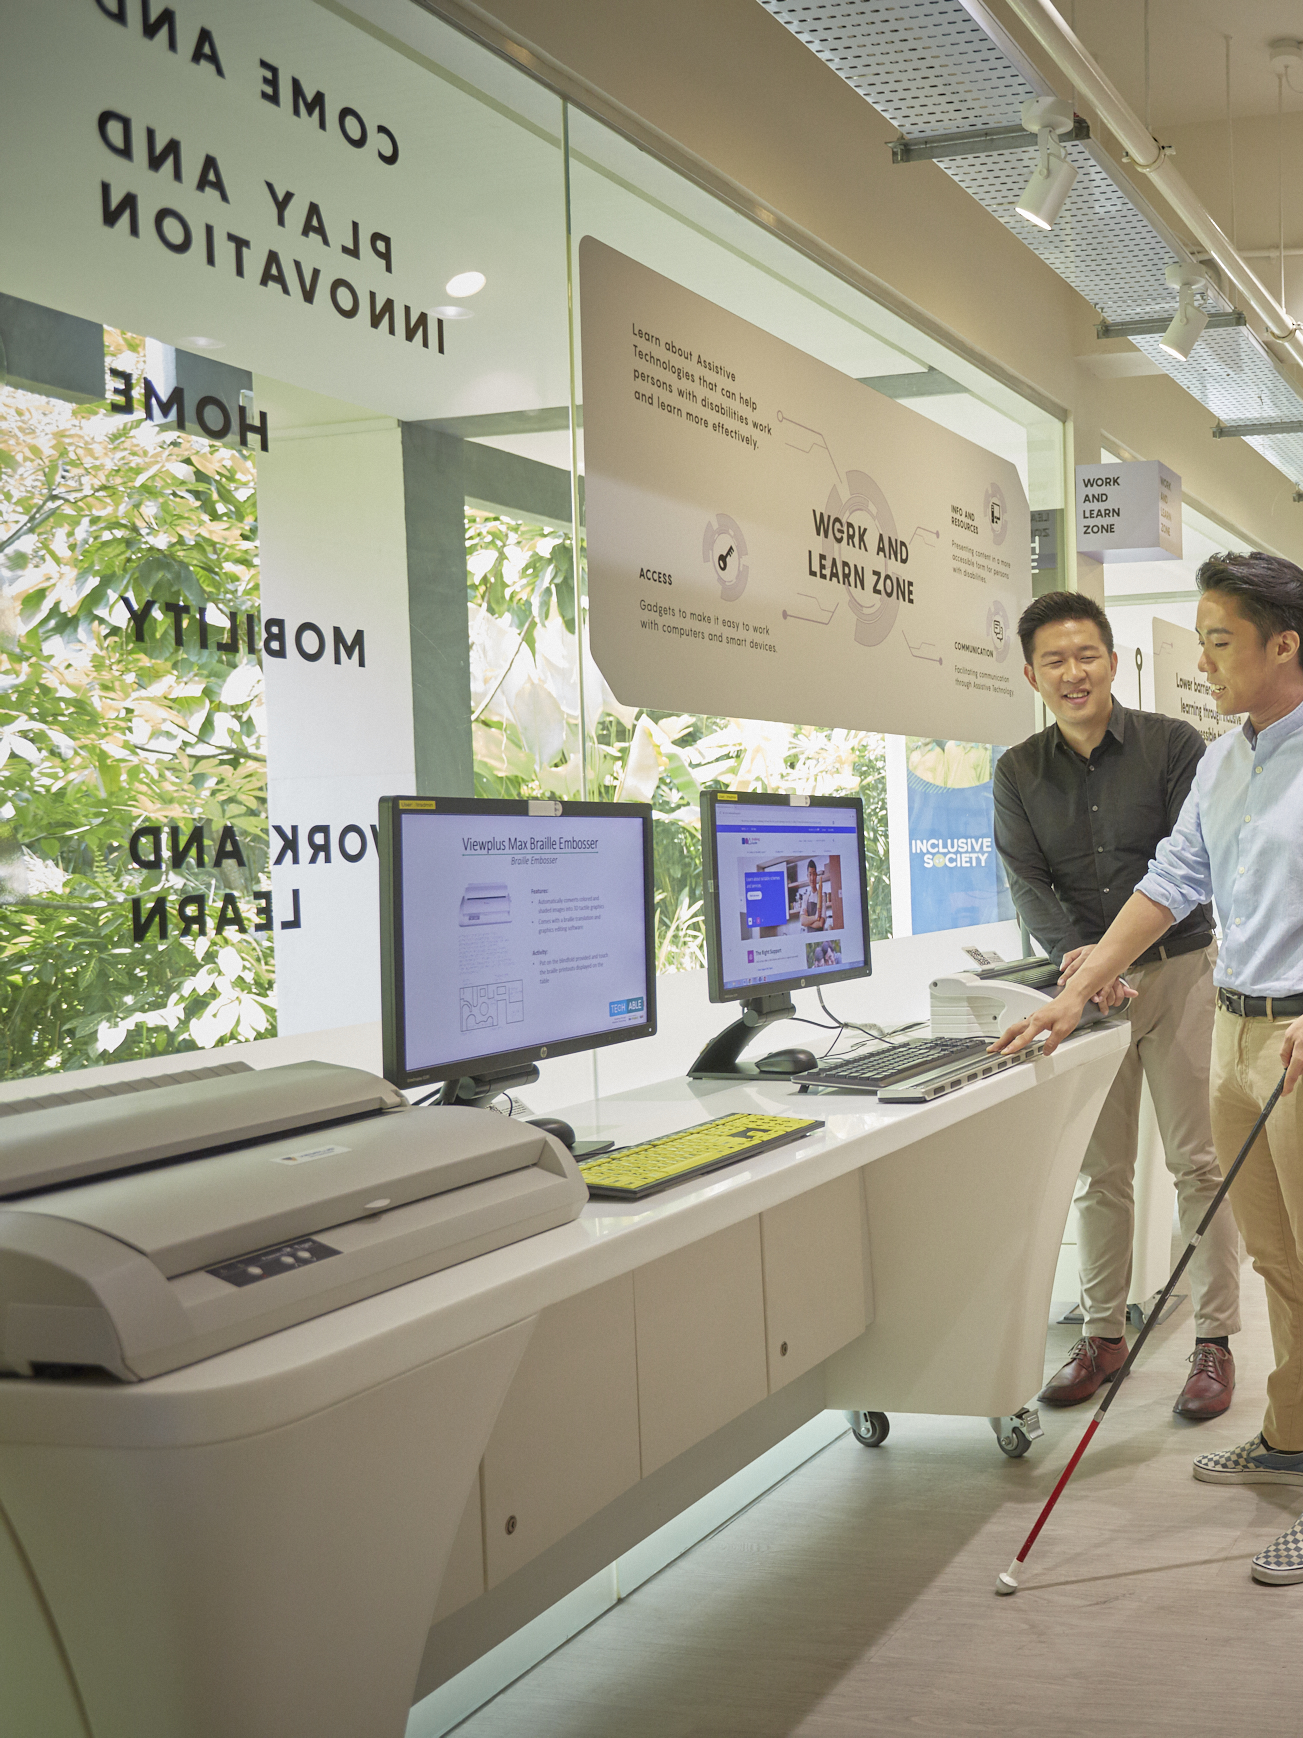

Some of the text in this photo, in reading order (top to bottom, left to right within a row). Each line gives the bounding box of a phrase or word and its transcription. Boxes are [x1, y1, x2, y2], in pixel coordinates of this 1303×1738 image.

[632, 323, 736, 382] Learn about Assistive
[632, 344, 758, 413] Technologies that can help
[633, 368, 772, 436] persons with disabilities work
[634, 389, 760, 451] and learn more effectively.
[1082, 476, 1120, 488] WORK
[1160, 476, 1172, 491] WORK
[1082, 493, 1108, 504] AND
[1160, 492, 1168, 504] AND
[951, 504, 976, 522] INFO AND
[1082, 508, 1120, 520] LEARN
[1160, 507, 1172, 522] LEARN
[951, 516, 979, 535] RESOURCES
[1083, 524, 1116, 535] ZONE
[1160, 522, 1170, 537] ZONE
[812, 509, 909, 564] WORK AND
[951, 539, 974, 557] Presenting
[975, 550, 991, 562] content
[1000, 560, 1011, 568] more
[952, 554, 974, 568] accessible
[976, 560, 986, 571] form
[993, 568, 1010, 580] persons
[952, 566, 962, 575] with
[639, 567, 673, 586] ACCESS
[808, 550, 914, 605] LEARN ZONE
[640, 599, 770, 636] Gadgets to make it easy to work
[640, 619, 778, 653] with computers and smart devices.
[954, 642, 994, 658] COMMUNICATION
[954, 664, 1010, 683] Facilitating communication
[973, 682, 991, 692] Assistive
[1176, 672, 1212, 696] Lower barrier
[1180, 696, 1202, 722] learning
[462, 836, 598, 854] Viewplus Max Braille Embosser
[912, 838, 992, 854] INCLUSIVE
[510, 856, 558, 866] Braille Embosser
[611, 1000, 642, 1014] TECH ABLE
